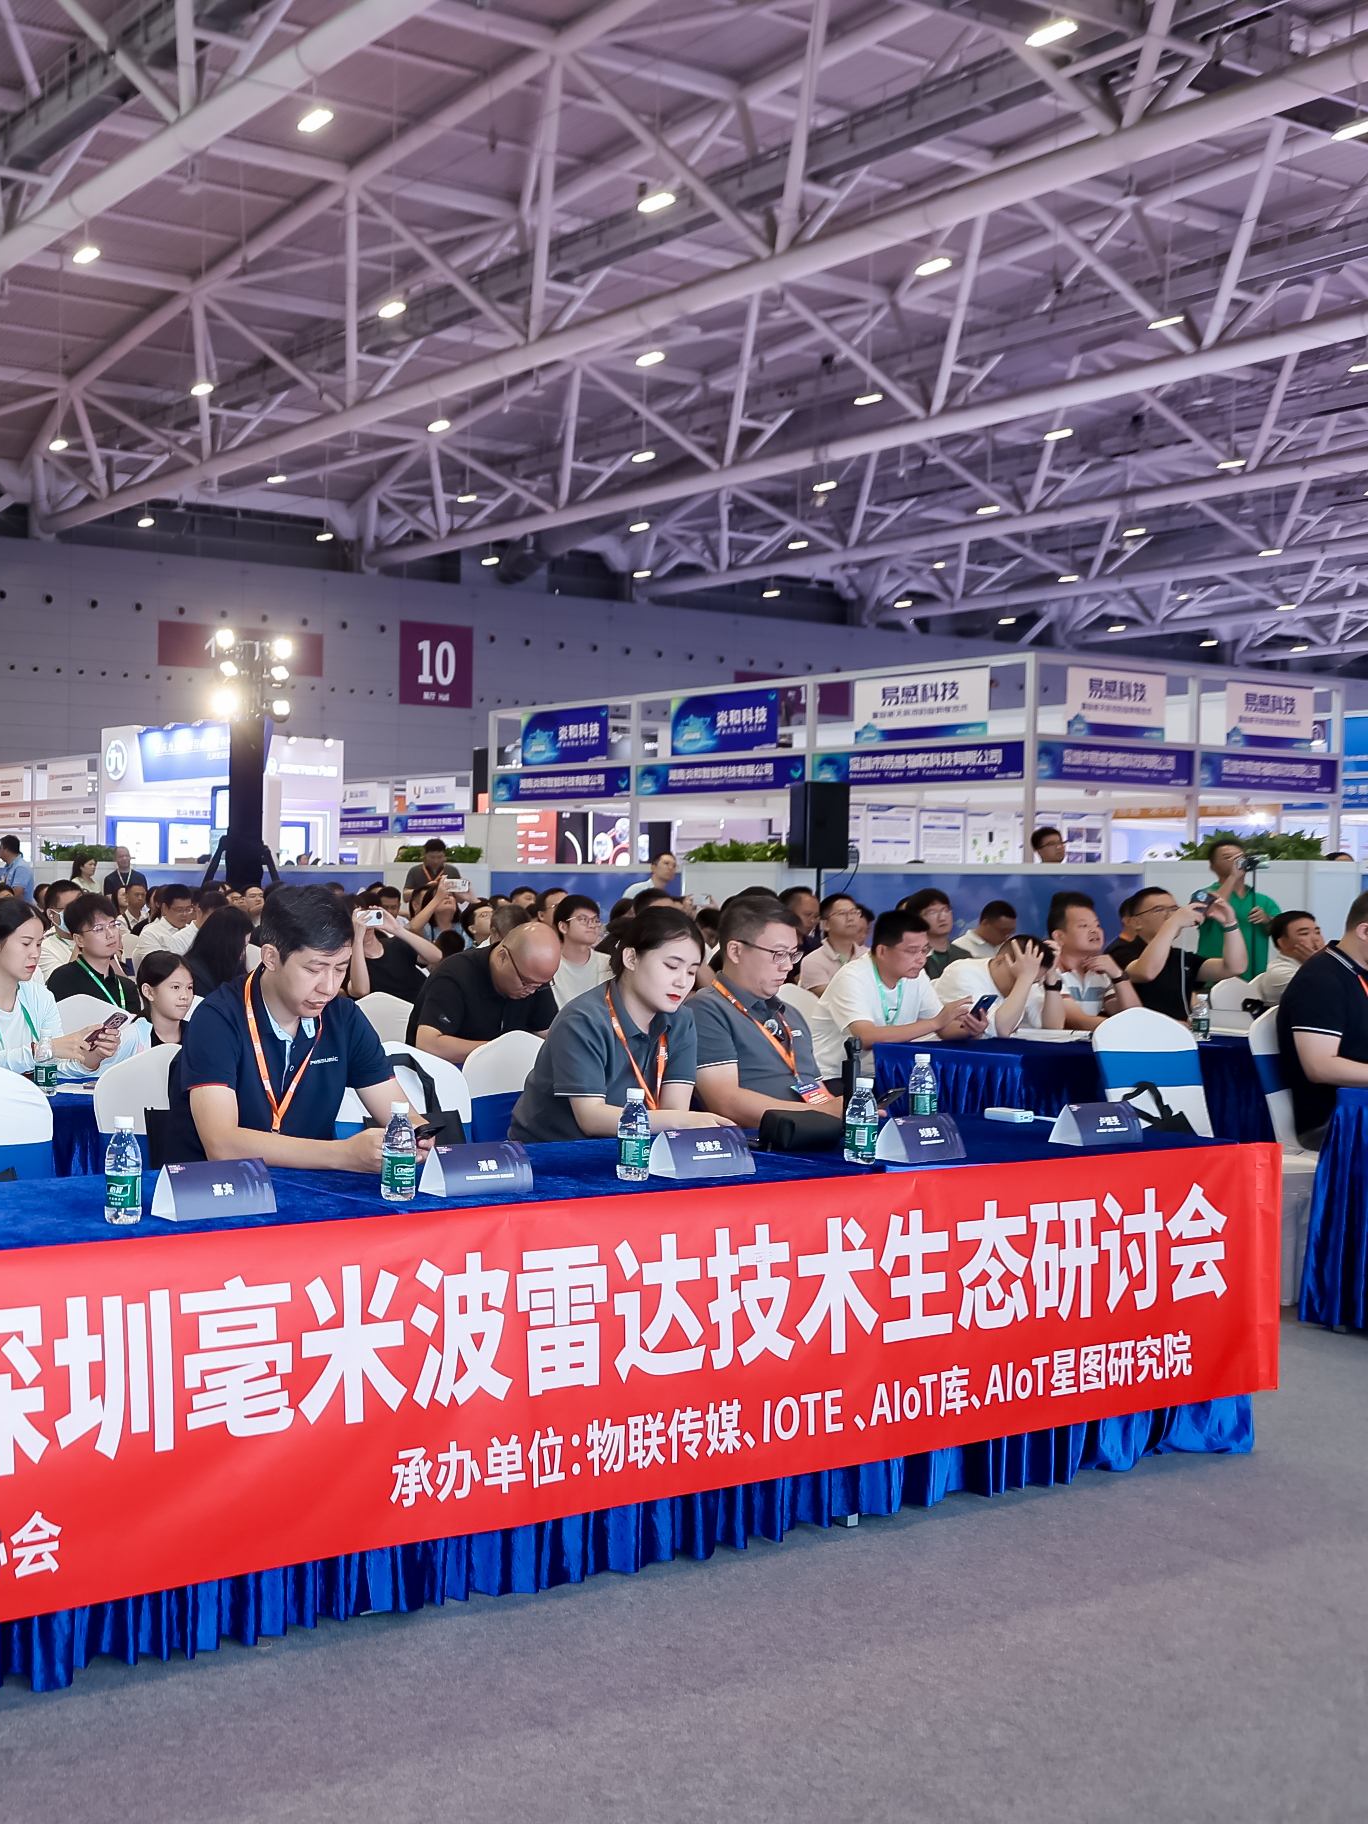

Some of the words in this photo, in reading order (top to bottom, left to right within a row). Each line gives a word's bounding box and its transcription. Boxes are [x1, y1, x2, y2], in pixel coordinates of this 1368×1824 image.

[417, 640, 456, 687] 10
[880, 680, 960, 707] 易感科技
[1088, 678, 1147, 702] 易感科技
[1244, 692, 1296, 714] 易感科技
[715, 705, 768, 728] 炎和科技
[557, 722, 600, 740] 炎和科技
[211, 1182, 235, 1197] 嘉宾
